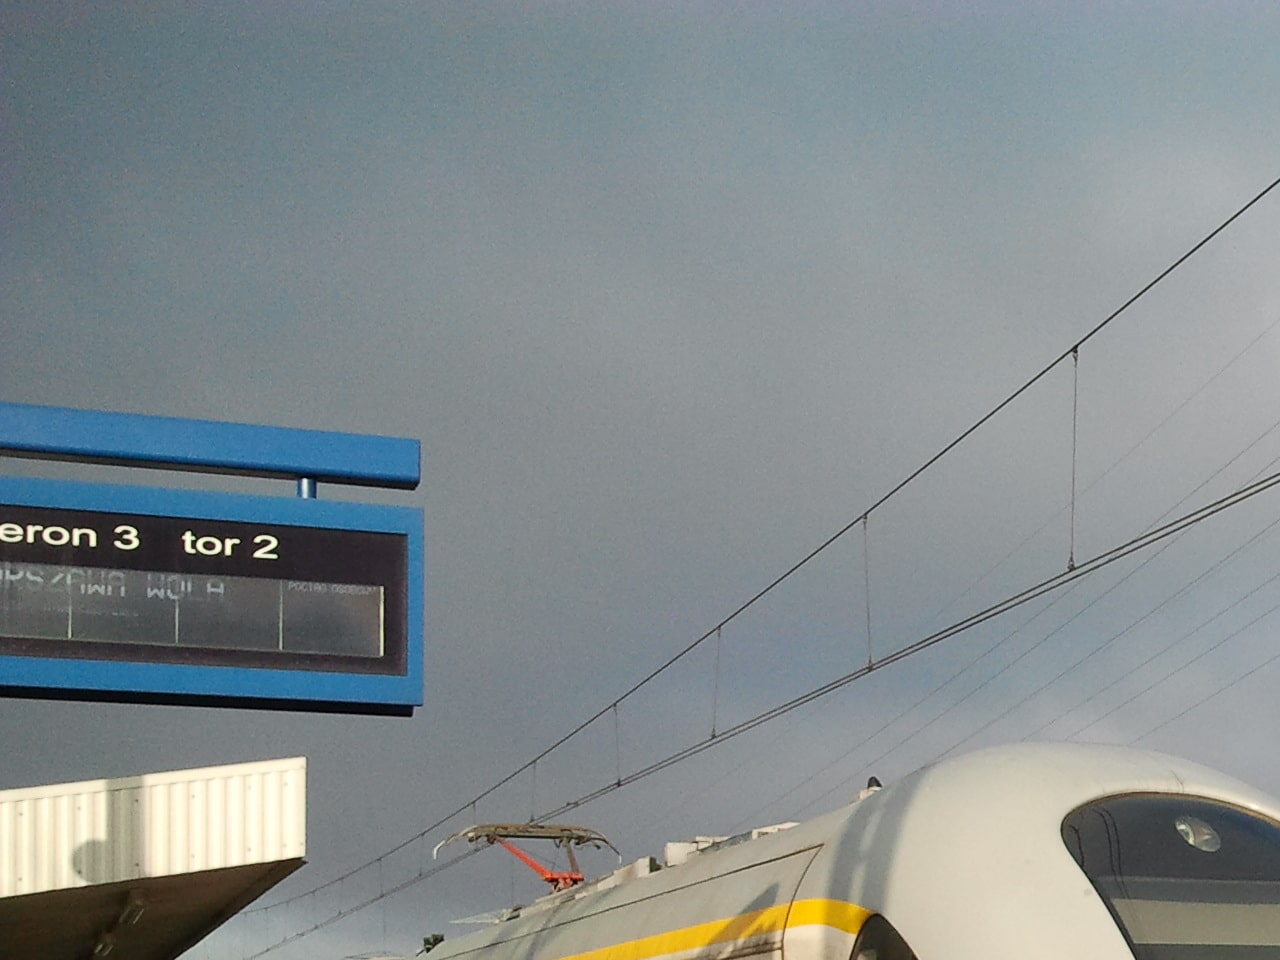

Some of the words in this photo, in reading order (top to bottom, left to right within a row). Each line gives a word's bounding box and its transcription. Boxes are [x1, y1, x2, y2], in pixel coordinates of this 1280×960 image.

[113, 525, 140, 550] 3
[181, 530, 241, 556] tor
[252, 534, 279, 559] 2
